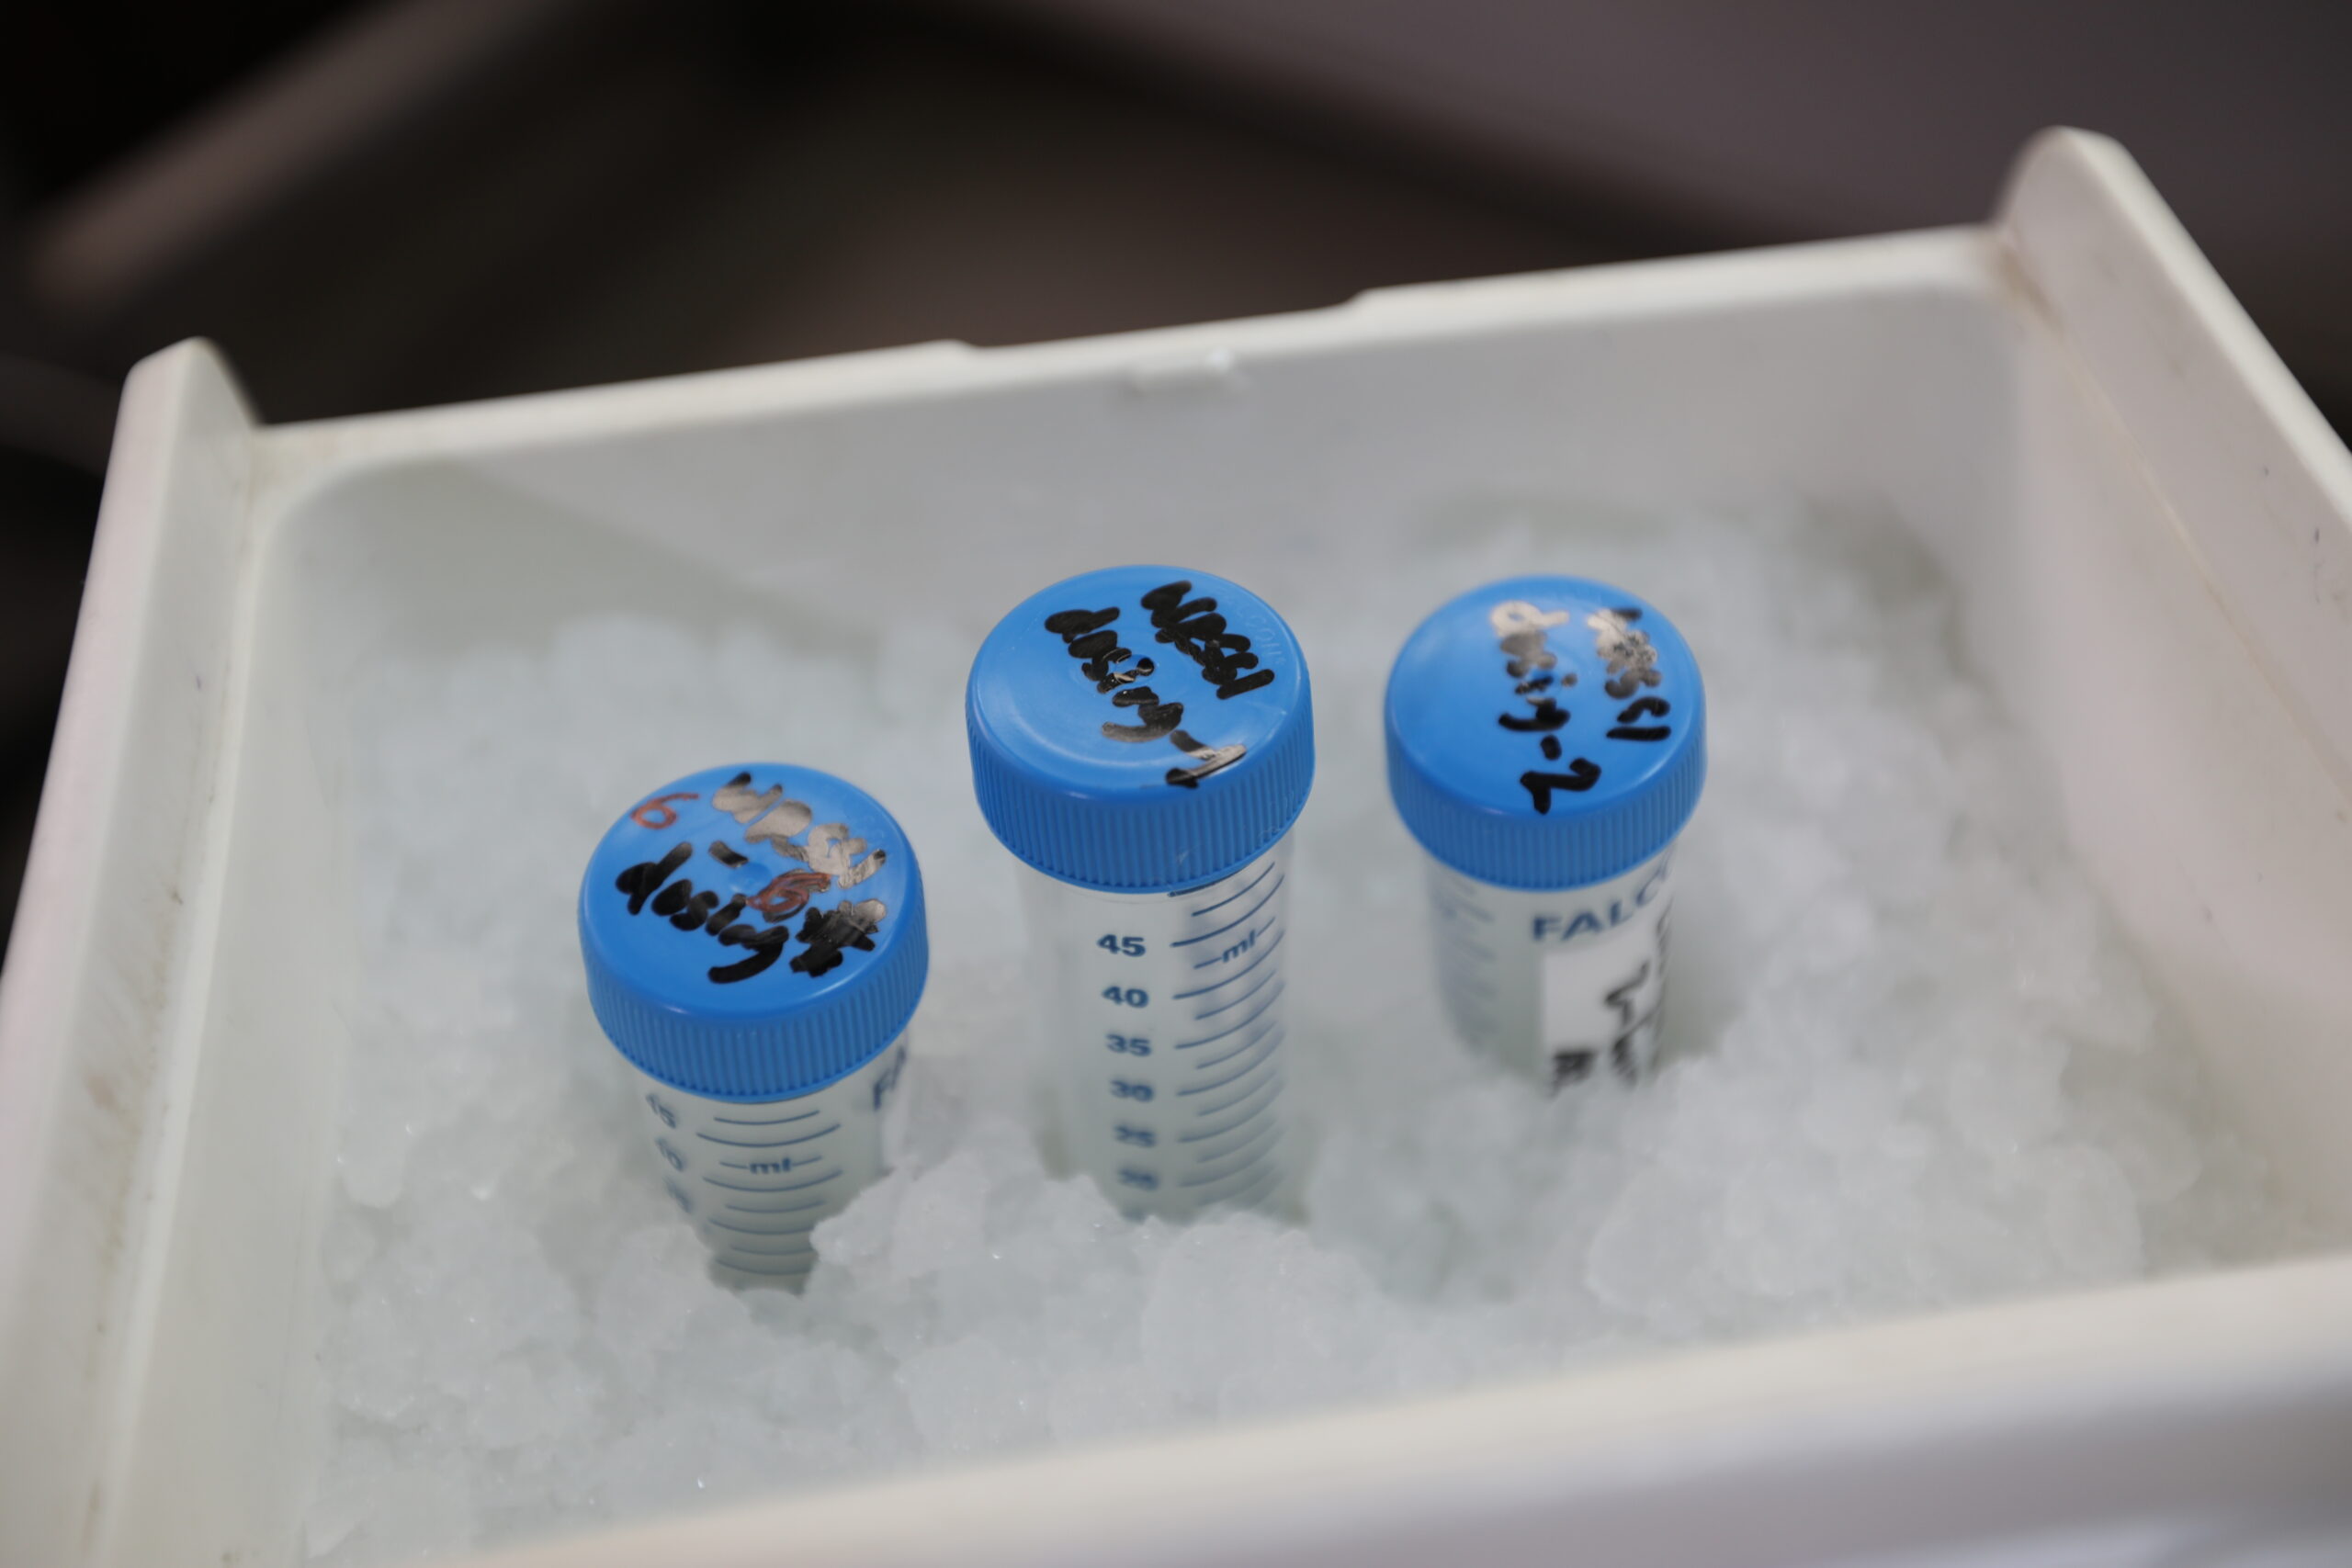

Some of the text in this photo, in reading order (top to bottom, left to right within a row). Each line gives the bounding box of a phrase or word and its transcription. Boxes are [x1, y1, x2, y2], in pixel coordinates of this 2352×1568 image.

[1097, 933, 1147, 958] 45
[1222, 929, 1257, 964] ml
[1102, 986, 1149, 1010] 40
[1106, 1033, 1153, 1057] 35
[1110, 1078, 1155, 1103] 30
[749, 1156, 791, 1175] ml
